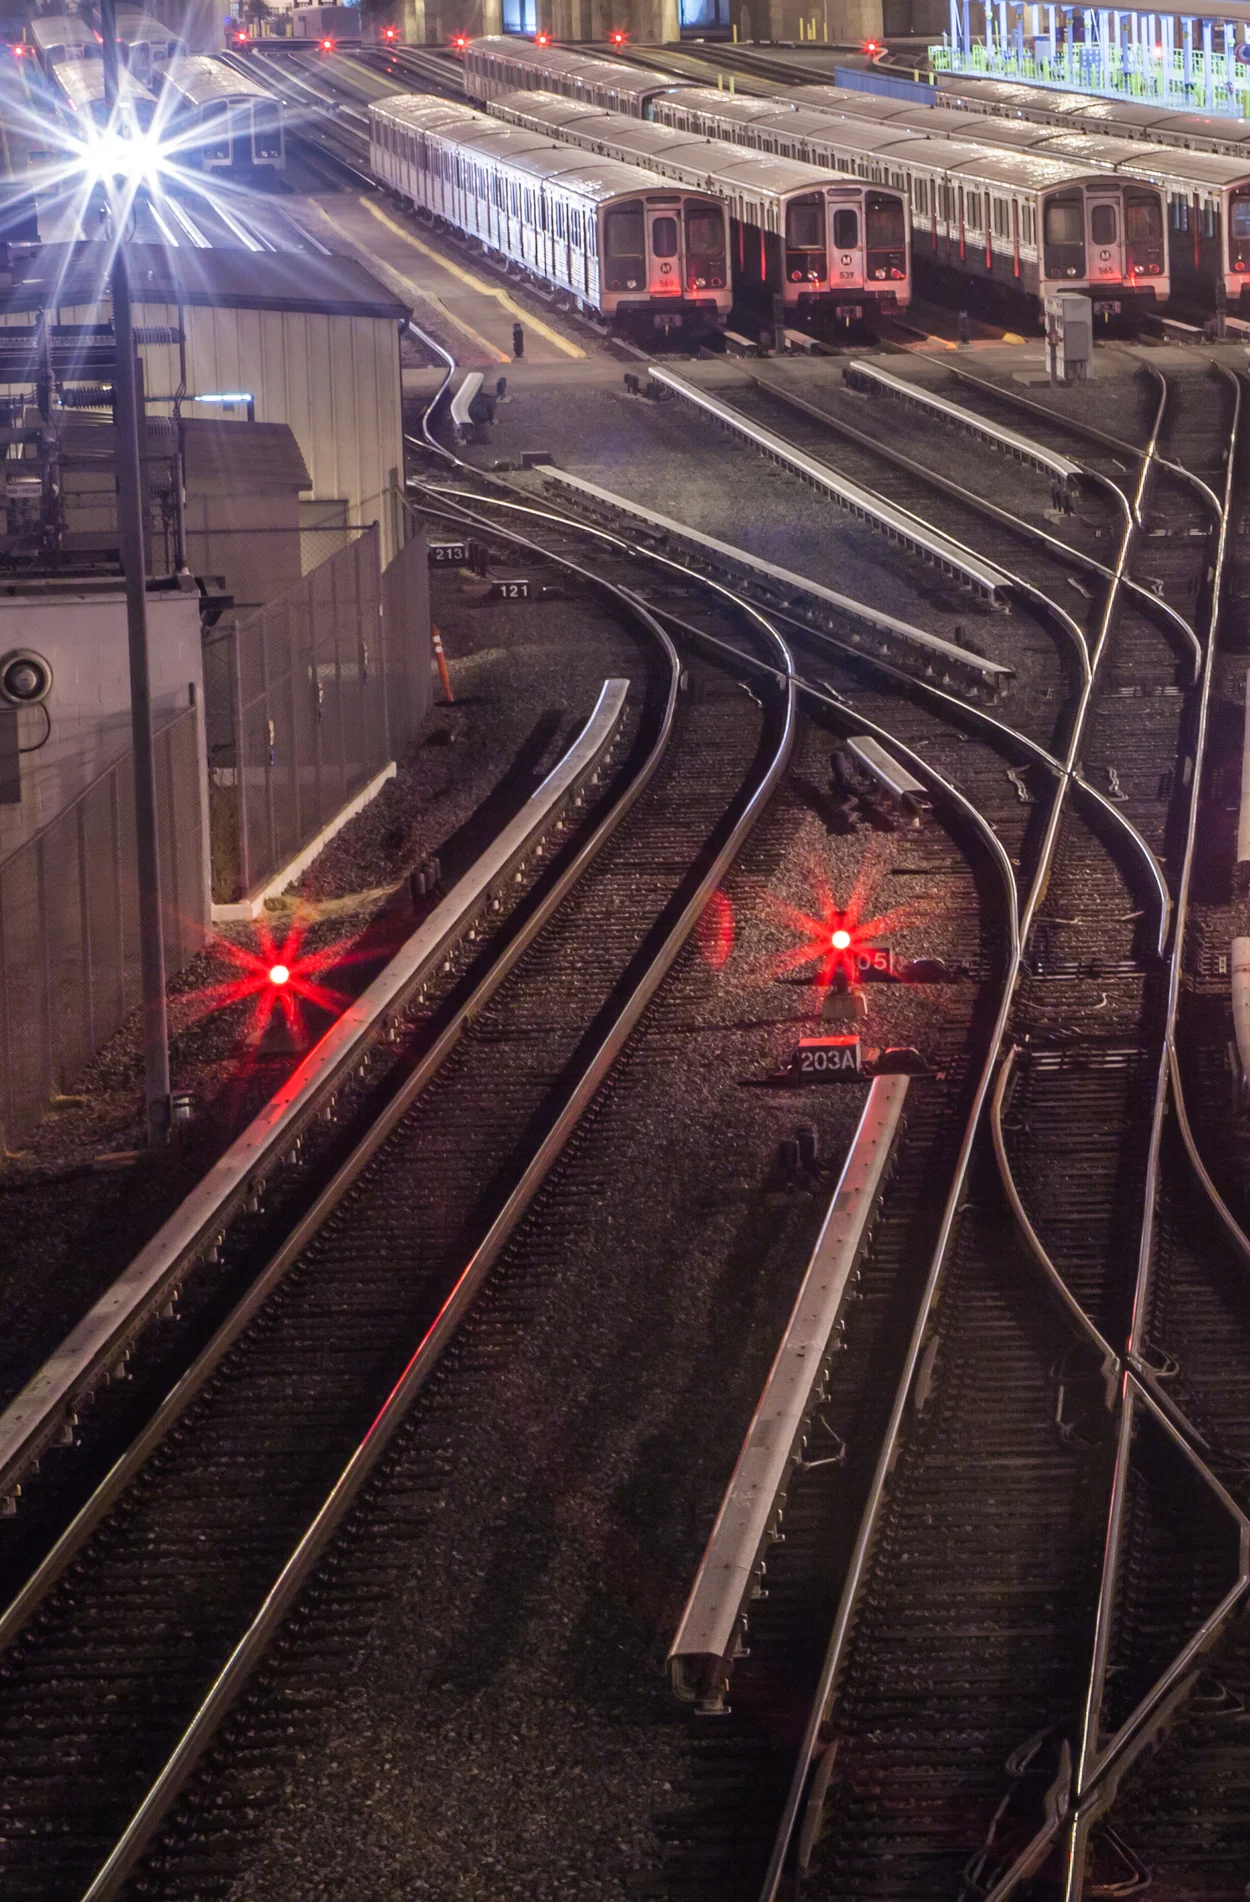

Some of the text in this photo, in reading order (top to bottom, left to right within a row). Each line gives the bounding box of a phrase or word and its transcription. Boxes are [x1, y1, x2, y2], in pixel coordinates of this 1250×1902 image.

[841, 255, 852, 266] M
[1100, 250, 1111, 261] M
[660, 263, 672, 274] M
[1098, 266, 1114, 275] 565
[839, 271, 855, 279] 539
[435, 549, 463, 560] 213
[500, 585, 528, 597] 121
[856, 952, 888, 971] 05
[801, 1050, 855, 1071] 203A
